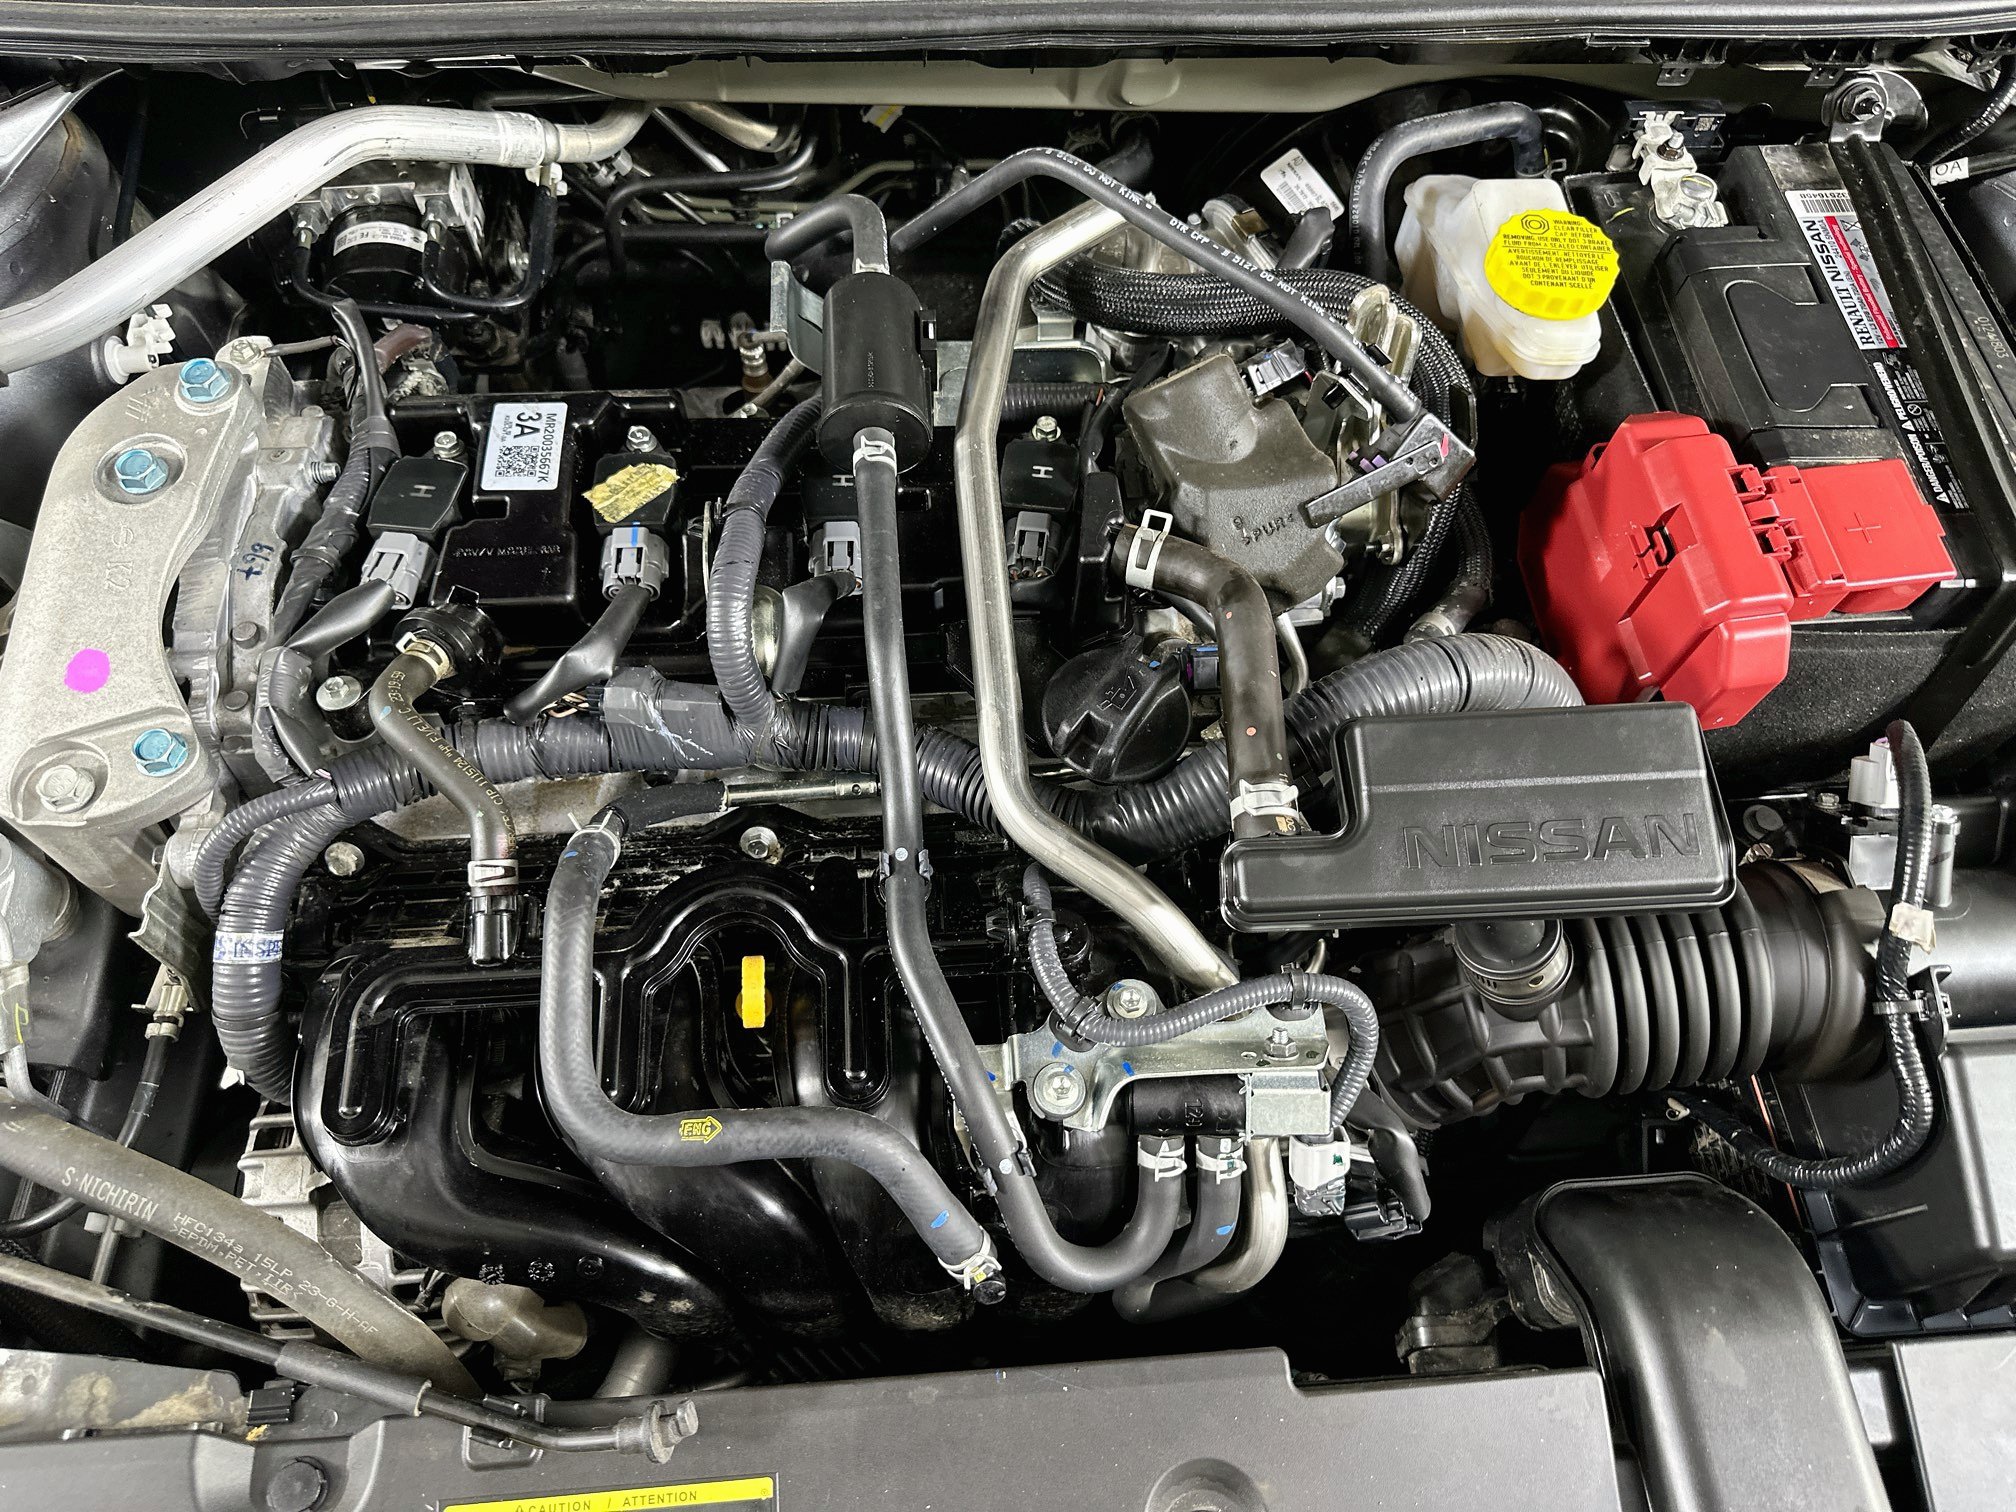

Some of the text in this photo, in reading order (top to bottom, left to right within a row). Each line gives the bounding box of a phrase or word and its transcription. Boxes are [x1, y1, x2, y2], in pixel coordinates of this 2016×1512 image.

[1260, 270, 1275, 282] DO
[1276, 281, 1298, 296] NOT
[1300, 296, 1325, 317] KINK
[1802, 220, 1875, 345] RENAULT NISSAN
[513, 412, 542, 438] 3A
[538, 413, 557, 483] MR20035667K
[1403, 813, 1701, 869] NISSAN
[622, 1491, 698, 1507] ATTENTION
